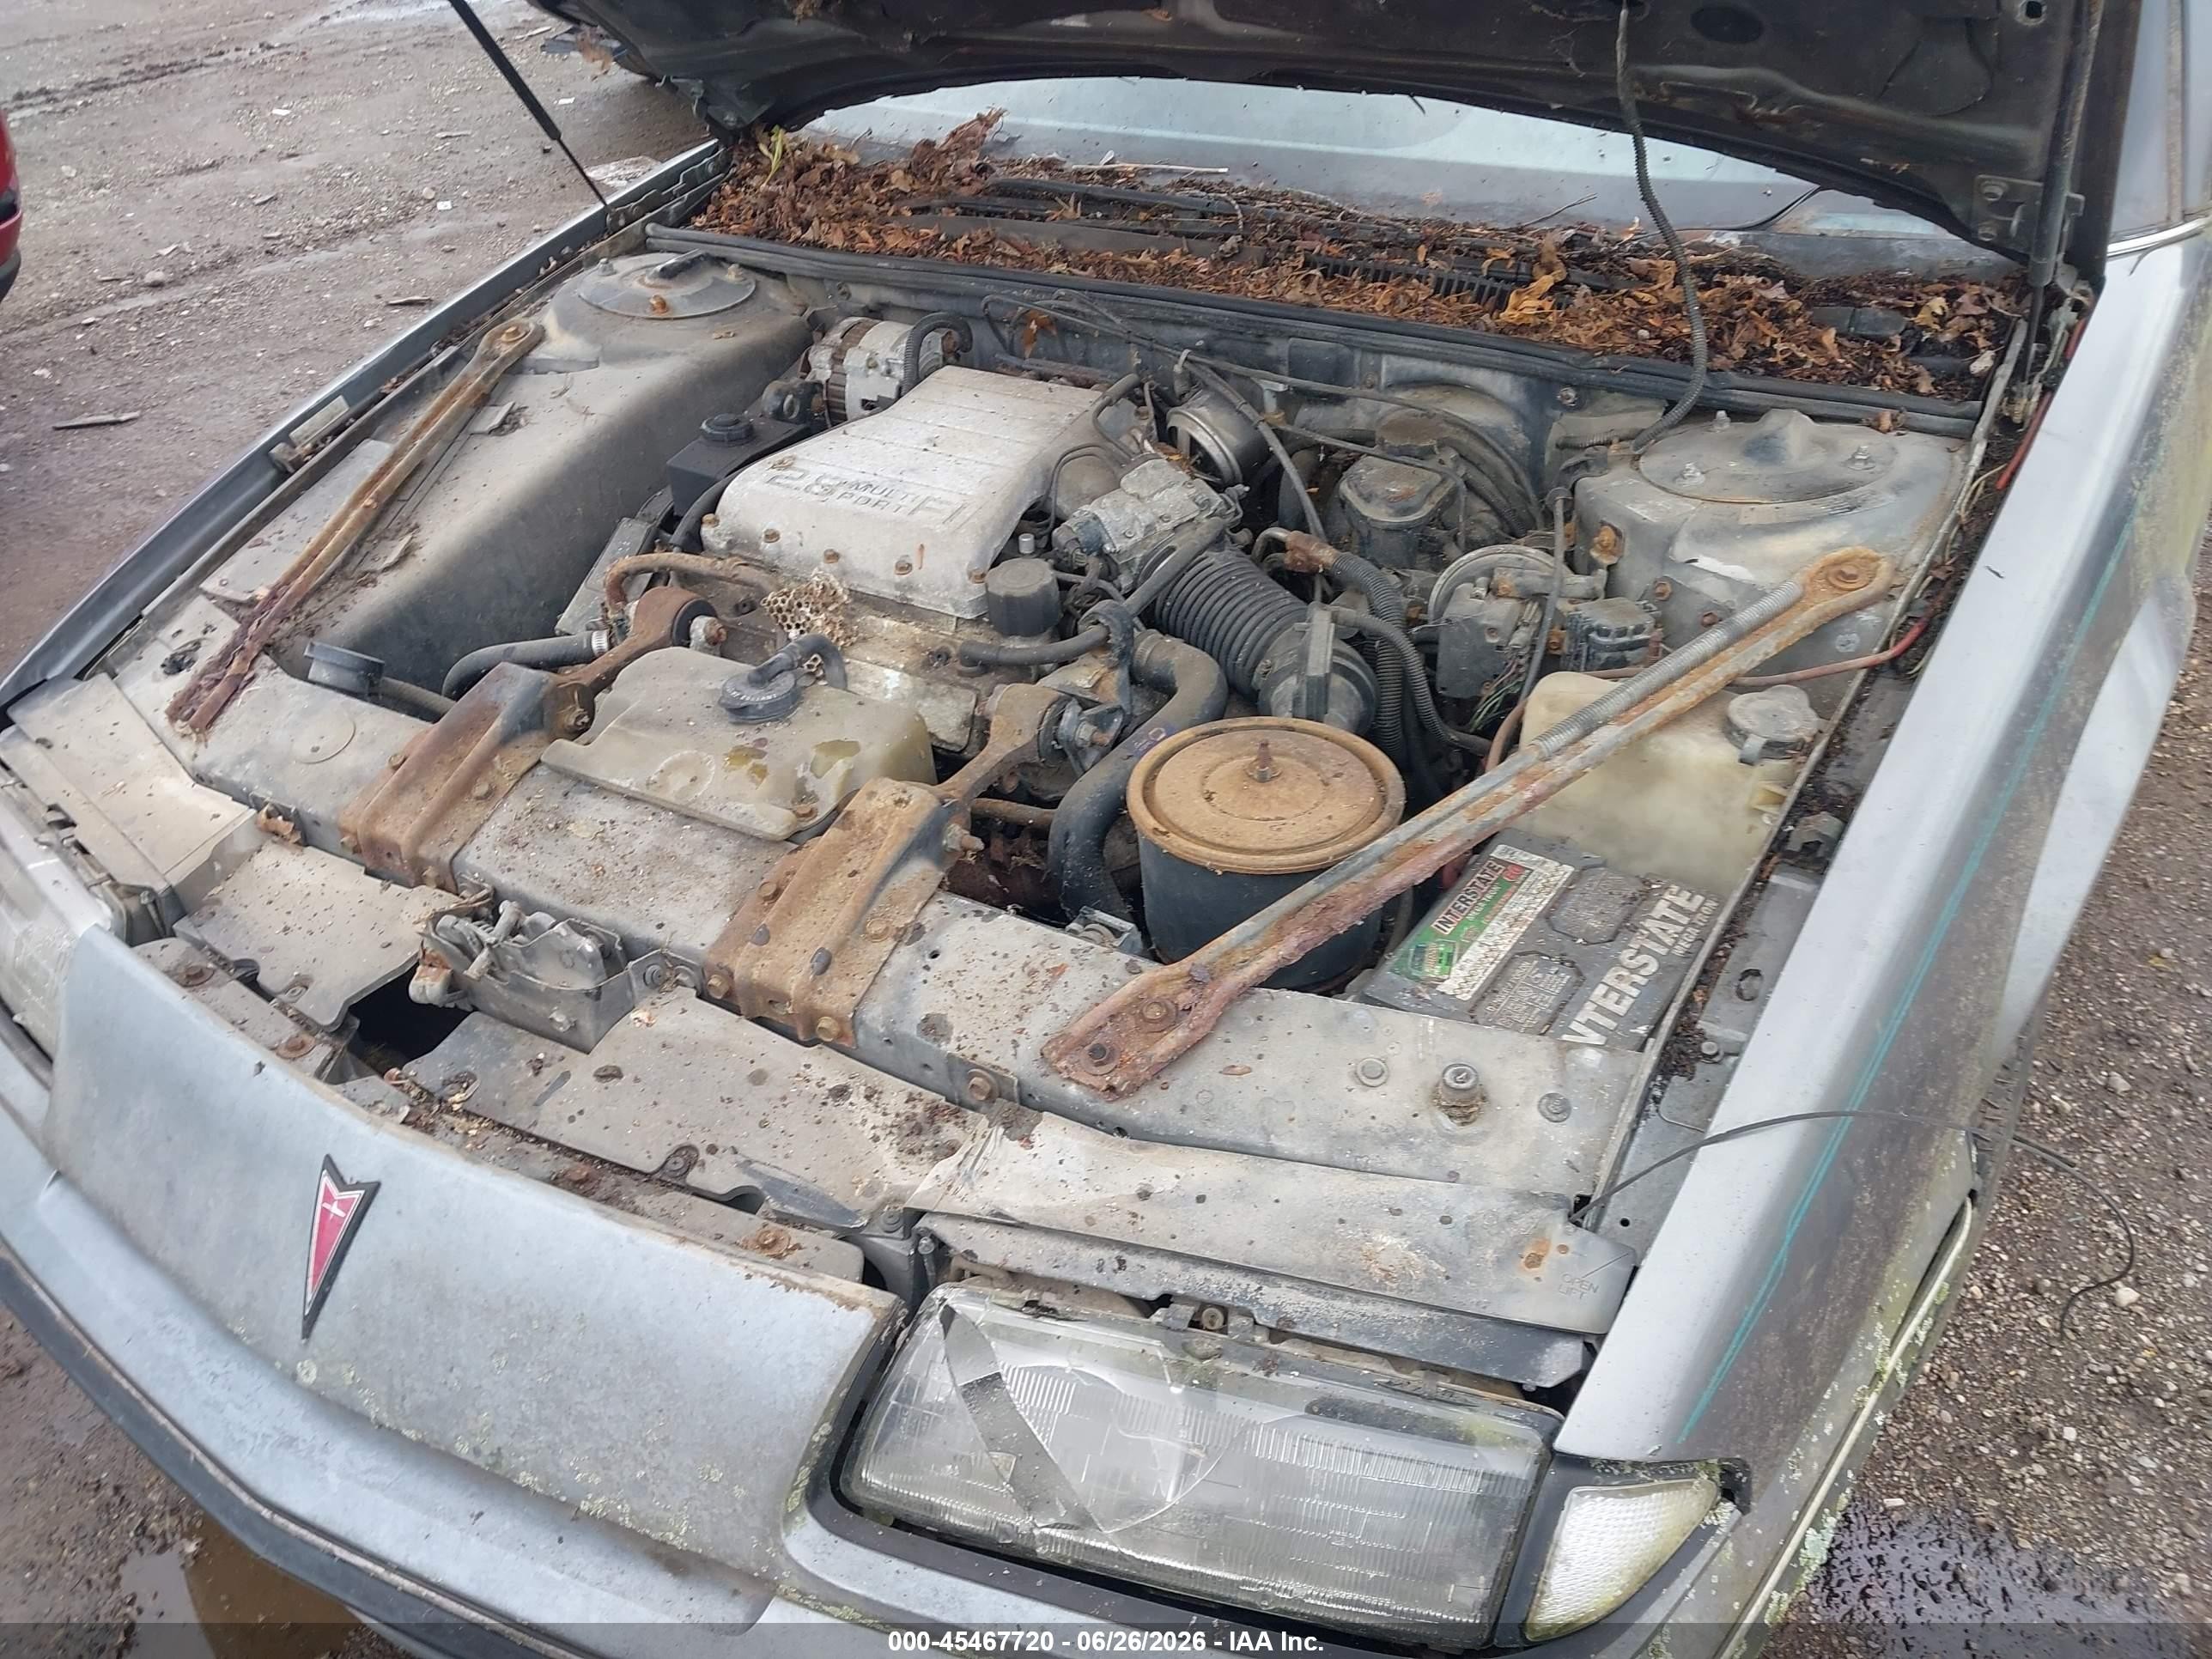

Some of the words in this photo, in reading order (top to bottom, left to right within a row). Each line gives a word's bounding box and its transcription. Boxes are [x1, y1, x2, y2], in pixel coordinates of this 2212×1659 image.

[845, 480, 917, 502] MULTI
[836, 492, 908, 514] PORT
[1432, 860, 1504, 934] INTERSTATE
[1561, 1273, 1599, 1293] OPEN
